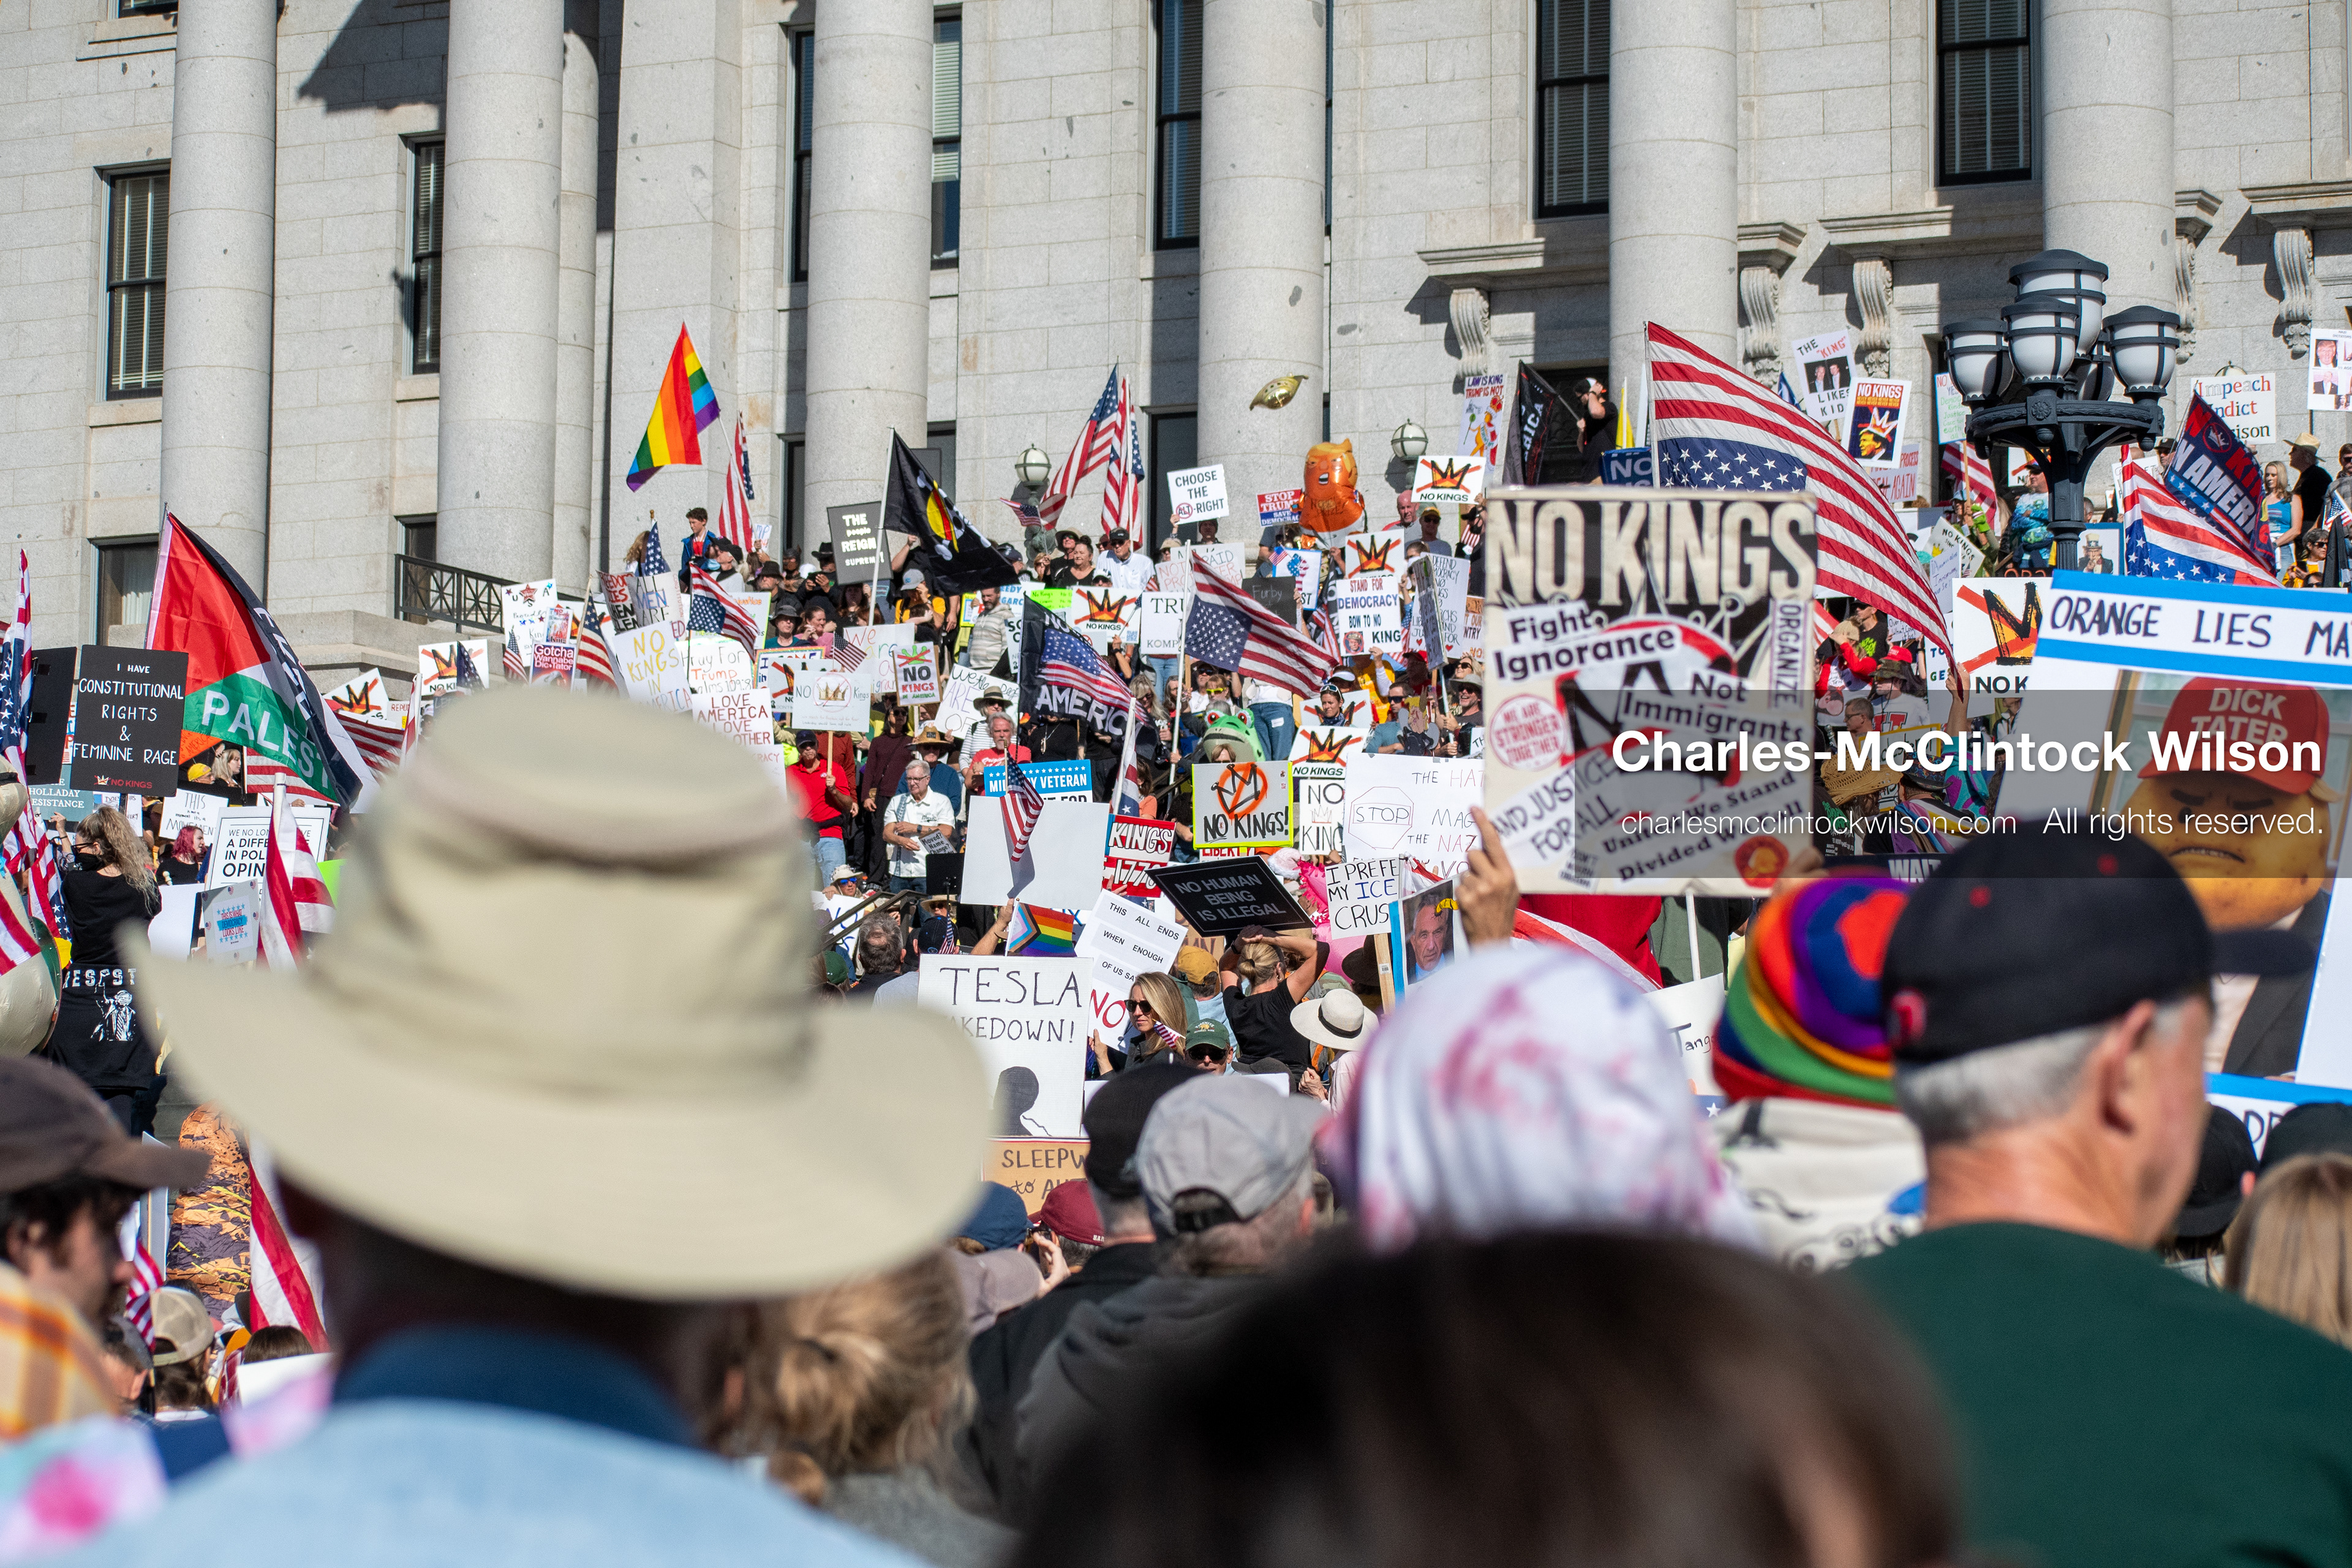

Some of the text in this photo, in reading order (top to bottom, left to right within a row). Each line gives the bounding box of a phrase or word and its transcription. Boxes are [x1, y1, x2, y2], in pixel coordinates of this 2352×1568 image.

[1796, 336, 1846, 358] THE "KING"
[1468, 374, 1503, 387] LAW IS KING
[1936, 375, 1948, 388] NO
[2198, 375, 2271, 399] Impeach
[1466, 385, 1504, 398] TRUMP IS NOT
[1858, 384, 1902, 399] NO KINGS
[1901, 451, 1918, 467] PROCESS
[1175, 470, 1217, 487] CHOOSE
[1890, 473, 1917, 500] AGAIN
[1188, 486, 1208, 500] THE
[1265, 490, 1295, 502] STOP
[842, 513, 867, 527] THE
[1262, 515, 1299, 526] DEMOCRAC
[846, 527, 871, 537] people
[841, 537, 876, 552] REIGN
[1487, 500, 1585, 606] NO
[1600, 500, 1817, 606] KINGS
[1942, 529, 1975, 562] NO KINGS
[845, 551, 884, 567] SUPREM!
[1433, 556, 1457, 570] DEFEND
[636, 575, 662, 594] ALL
[1351, 578, 1383, 592] STAND FOR
[636, 590, 668, 609] MEN
[1338, 594, 1398, 609] DEMOCRACY
[1349, 614, 1381, 628] BOW TO NO
[1509, 606, 1591, 644] Fight
[2050, 595, 2272, 648] ORANGE LIES
[633, 630, 665, 658] NO
[846, 627, 876, 646] We
[1444, 633, 1460, 646] FOR
[534, 644, 574, 658] Gotcha
[534, 654, 574, 665] Wannabe
[718, 647, 745, 664] For
[1494, 628, 1676, 681] Ignorance
[1774, 601, 1802, 708] ORGANIZE
[127, 665, 150, 674] HAVE
[627, 648, 679, 684] KINGS
[903, 666, 931, 682] NO
[691, 668, 737, 685] Trump
[951, 666, 977, 684] We
[78, 678, 184, 699] CONSTITUTIONAL
[648, 673, 662, 696] IN
[725, 679, 752, 692] 109:8
[796, 685, 812, 699] NO
[853, 686, 870, 701] Kings
[902, 682, 935, 693] KINGS
[1691, 673, 1747, 703] Not
[1975, 676, 2011, 694] NO
[712, 693, 751, 709] LOVE
[943, 681, 979, 714] ARE
[2208, 688, 2288, 720] DICK
[102, 704, 157, 722] RIGHTS
[697, 705, 769, 723] AMERICA
[1624, 692, 1803, 742] Immigrants
[119, 725, 131, 741] &
[713, 720, 753, 734] LOVE
[1494, 714, 1561, 748] STRONGER
[2191, 714, 2290, 747] TATER
[73, 743, 177, 766] FEMININE RAGE
[1506, 736, 1560, 763] TOGETHER
[1293, 766, 1344, 776] NO KINGS
[1412, 771, 1439, 785] THE
[125, 780, 153, 789] KINGS
[1040, 774, 1087, 789] VETERAN
[1529, 748, 1618, 821] JUSTICE
[28, 787, 81, 797] HOLLADAY
[1308, 783, 1344, 805] NO
[1684, 770, 1796, 820] We Stand
[185, 793, 206, 810] THIS
[1356, 806, 1409, 823] STOP
[1204, 805, 1289, 843] NO KINGS!
[1531, 794, 1622, 860] FOR ALL
[227, 839, 235, 848] A
[921, 832, 943, 846] Moved?
[928, 840, 945, 850] Name
[1108, 821, 1172, 854] KINGS
[1408, 834, 1430, 845] THE
[225, 850, 235, 860] IN
[930, 843, 951, 854] Change?
[1618, 835, 1714, 882] Divided
[1175, 874, 1262, 894] NO HUMAN
[1326, 867, 1340, 886] I
[1204, 890, 1256, 906] BEING
[1329, 878, 1397, 902] MY ICE
[233, 909, 243, 918] WHAT
[1197, 903, 1286, 921] IS ILLEGAL
[222, 917, 243, 929] DEMOCRACY
[1110, 902, 1180, 940] THIS ALL ENDS
[222, 925, 244, 937] LOOKS LIKE
[1104, 930, 1164, 963] WHEN ENOUGH
[1102, 961, 1123, 976] OF US
[940, 967, 1082, 1008] TESLA
[1090, 989, 1126, 1028] NO
[1011, 1179, 1035, 1194] to
